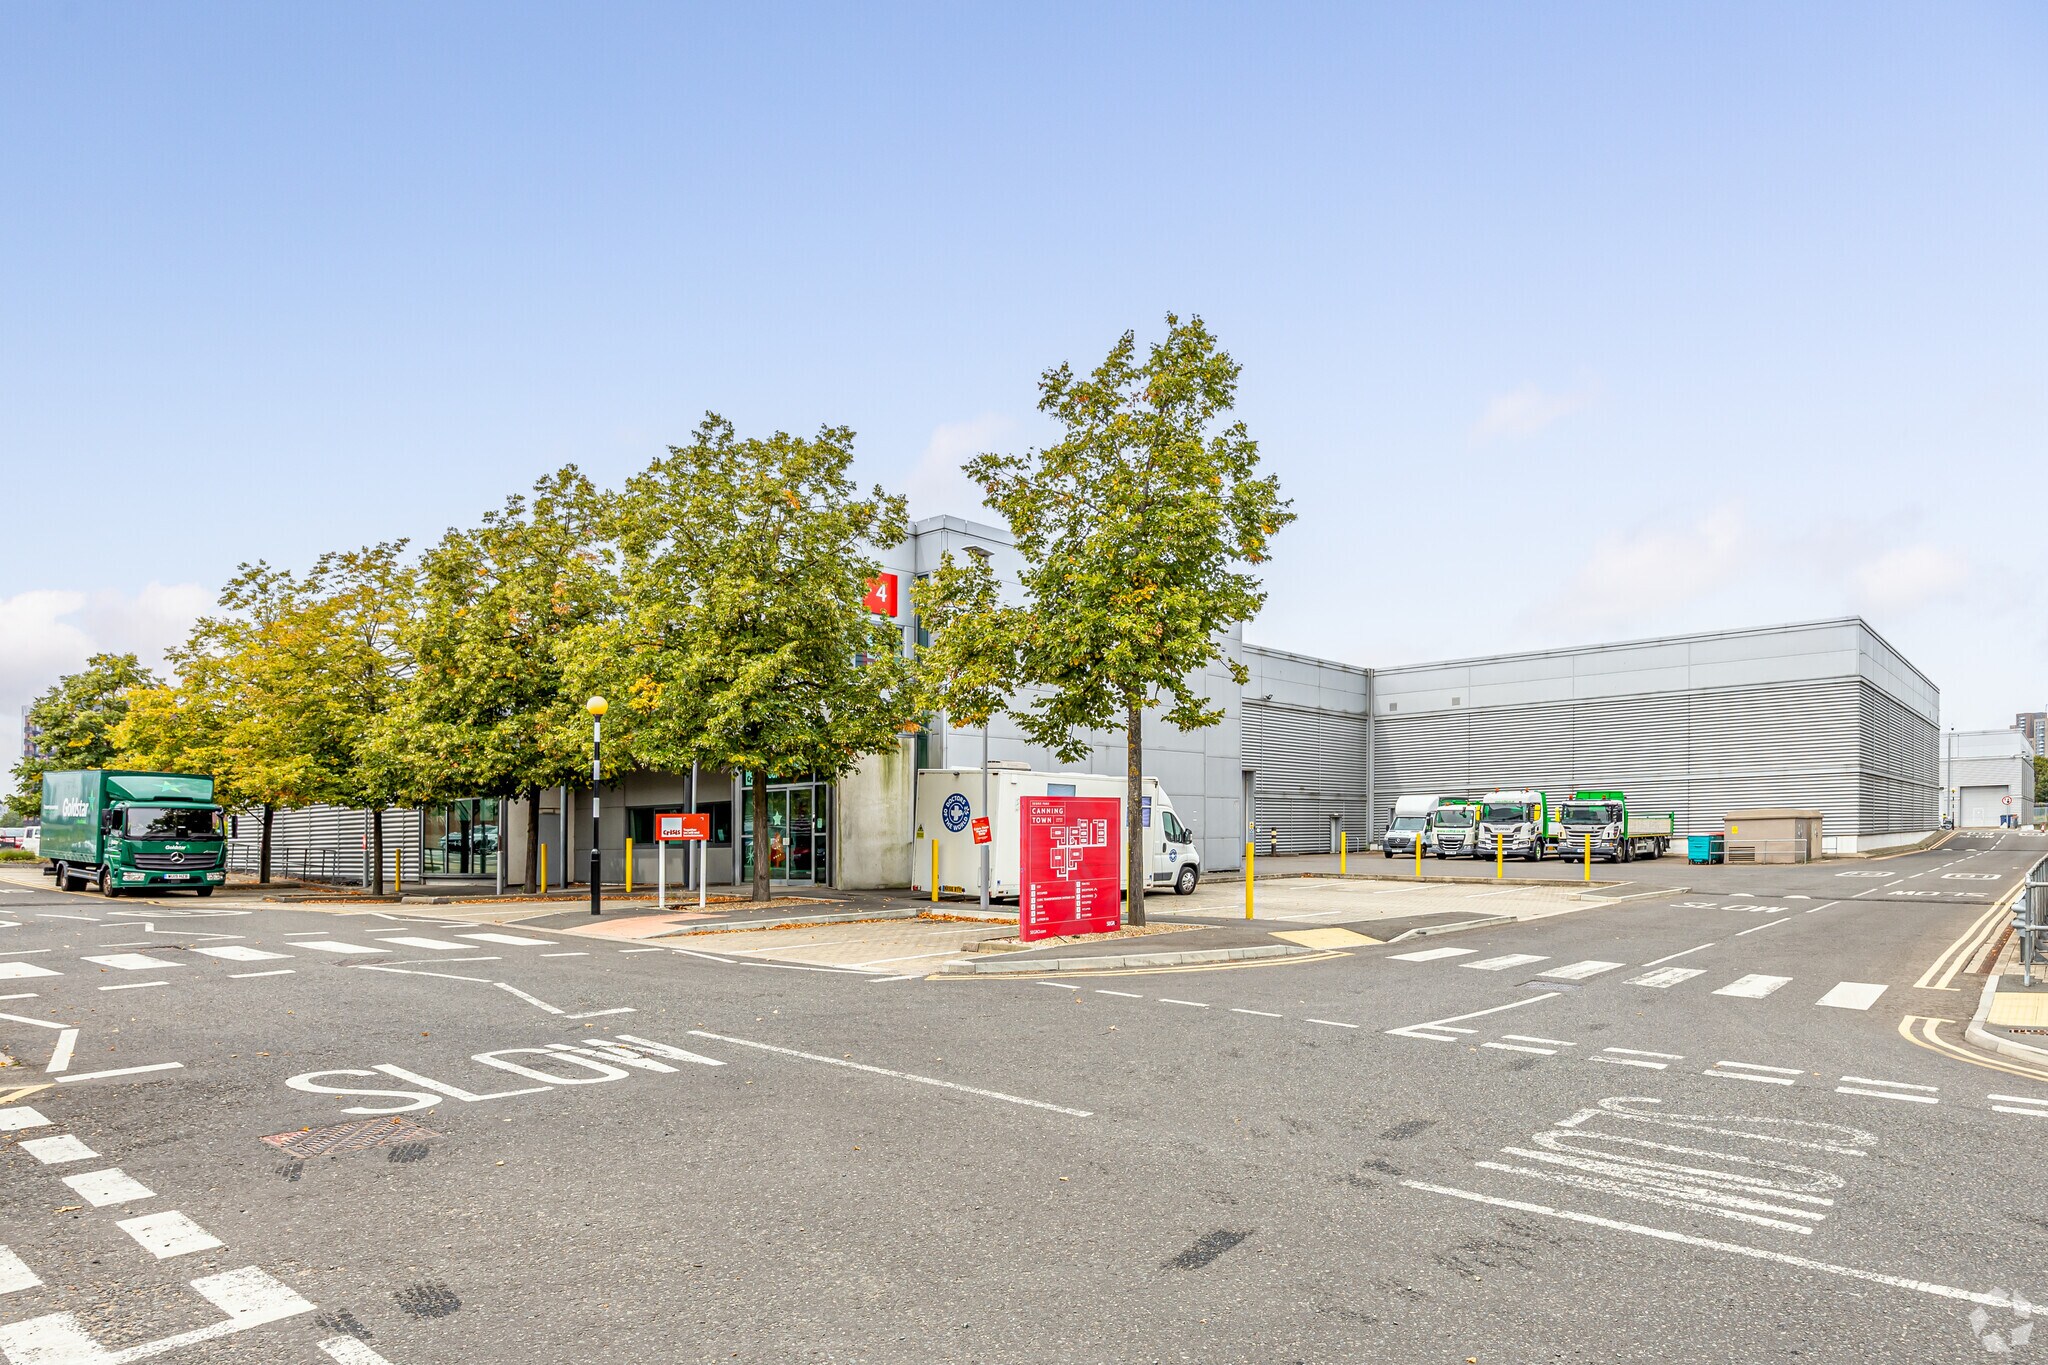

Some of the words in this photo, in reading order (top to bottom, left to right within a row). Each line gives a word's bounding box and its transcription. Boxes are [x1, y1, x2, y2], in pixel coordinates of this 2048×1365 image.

[875, 584, 888, 603] 4
[62, 797, 89, 817] Goldstar
[945, 795, 966, 808] DOCTORS
[943, 808, 948, 817] OF
[1031, 807, 1064, 815] CANNING
[944, 817, 953, 830] THE
[953, 816, 969, 831] WORLD
[1031, 816, 1052, 824] TOWN
[164, 843, 187, 851] Goldstar
[1887, 890, 1989, 898] SLOW
[1670, 902, 1789, 913] SLOW
[285, 1034, 728, 1114] SLOW
[1474, 1096, 1878, 1235] SLOW
